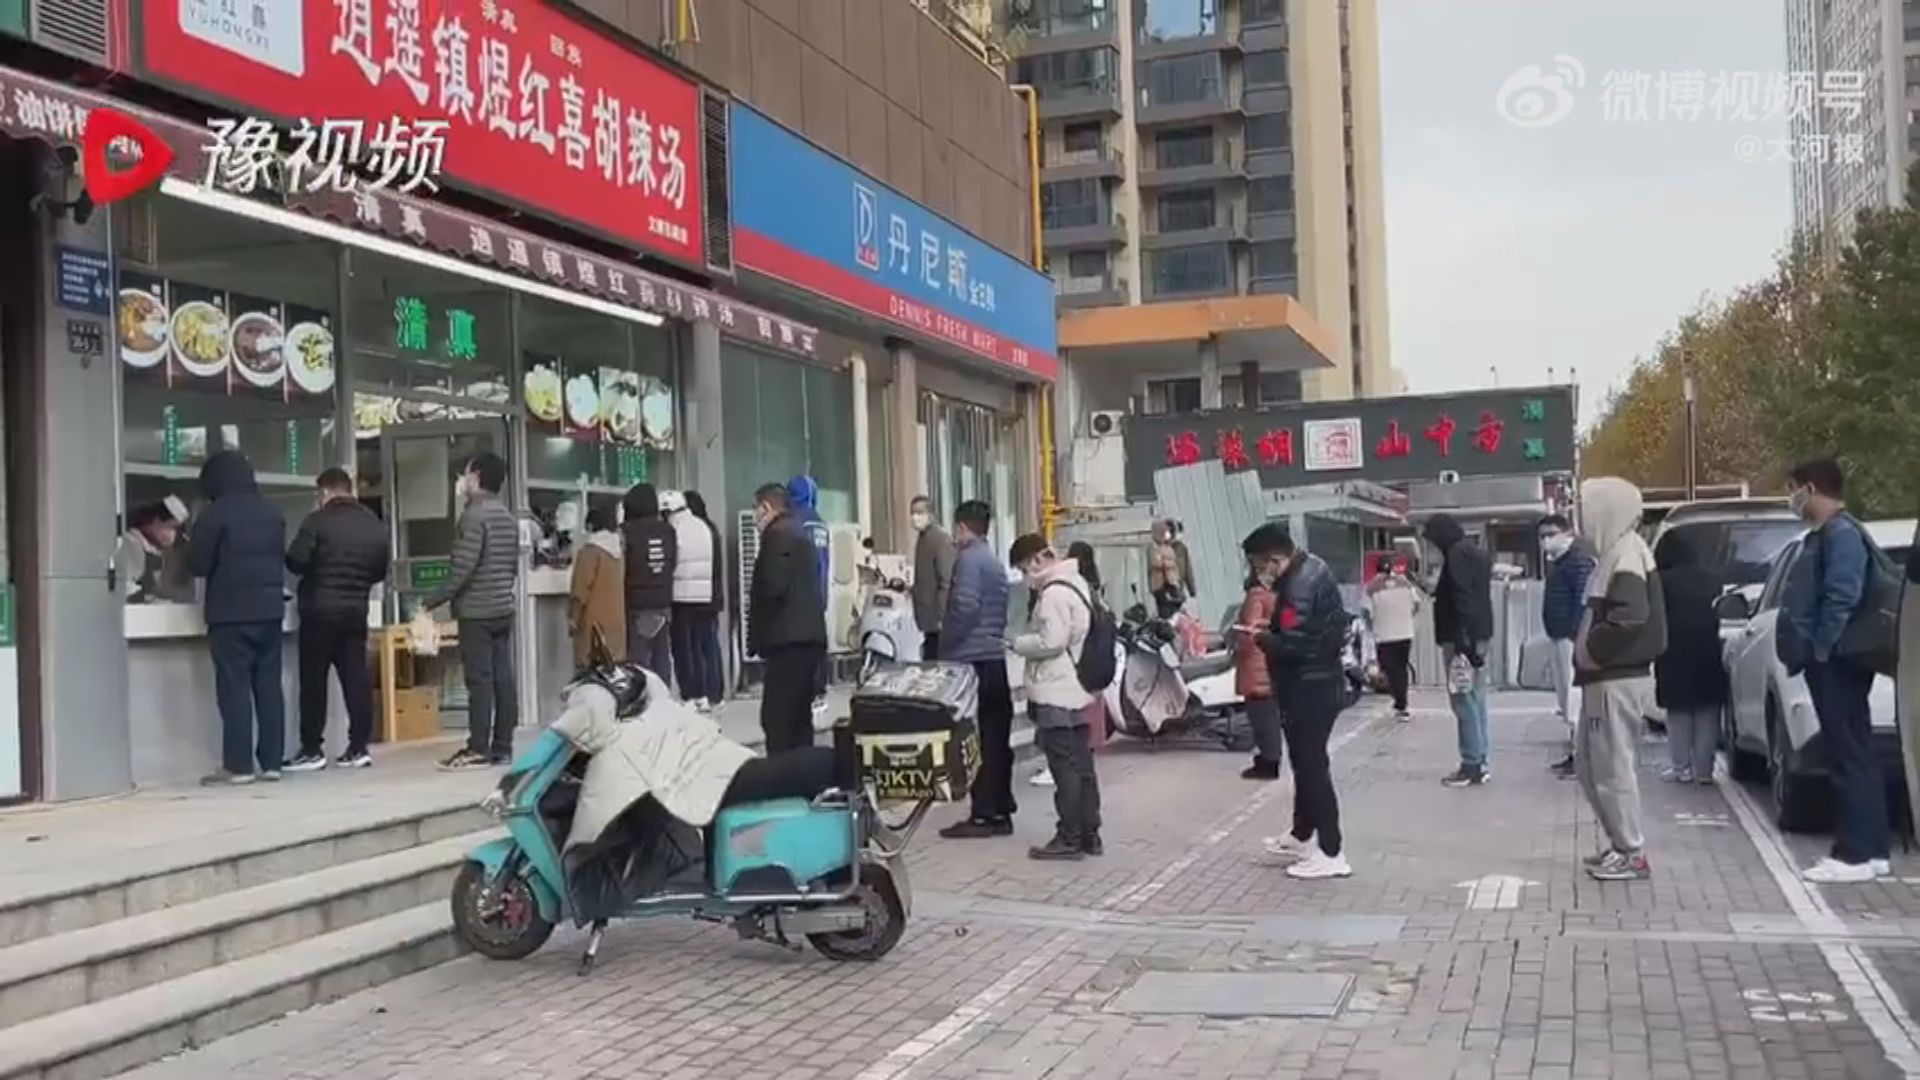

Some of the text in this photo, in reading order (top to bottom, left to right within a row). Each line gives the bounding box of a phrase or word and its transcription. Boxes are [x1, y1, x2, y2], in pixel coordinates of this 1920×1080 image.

[889, 213, 969, 302] 丹尼斯
[393, 296, 477, 360] 清真
